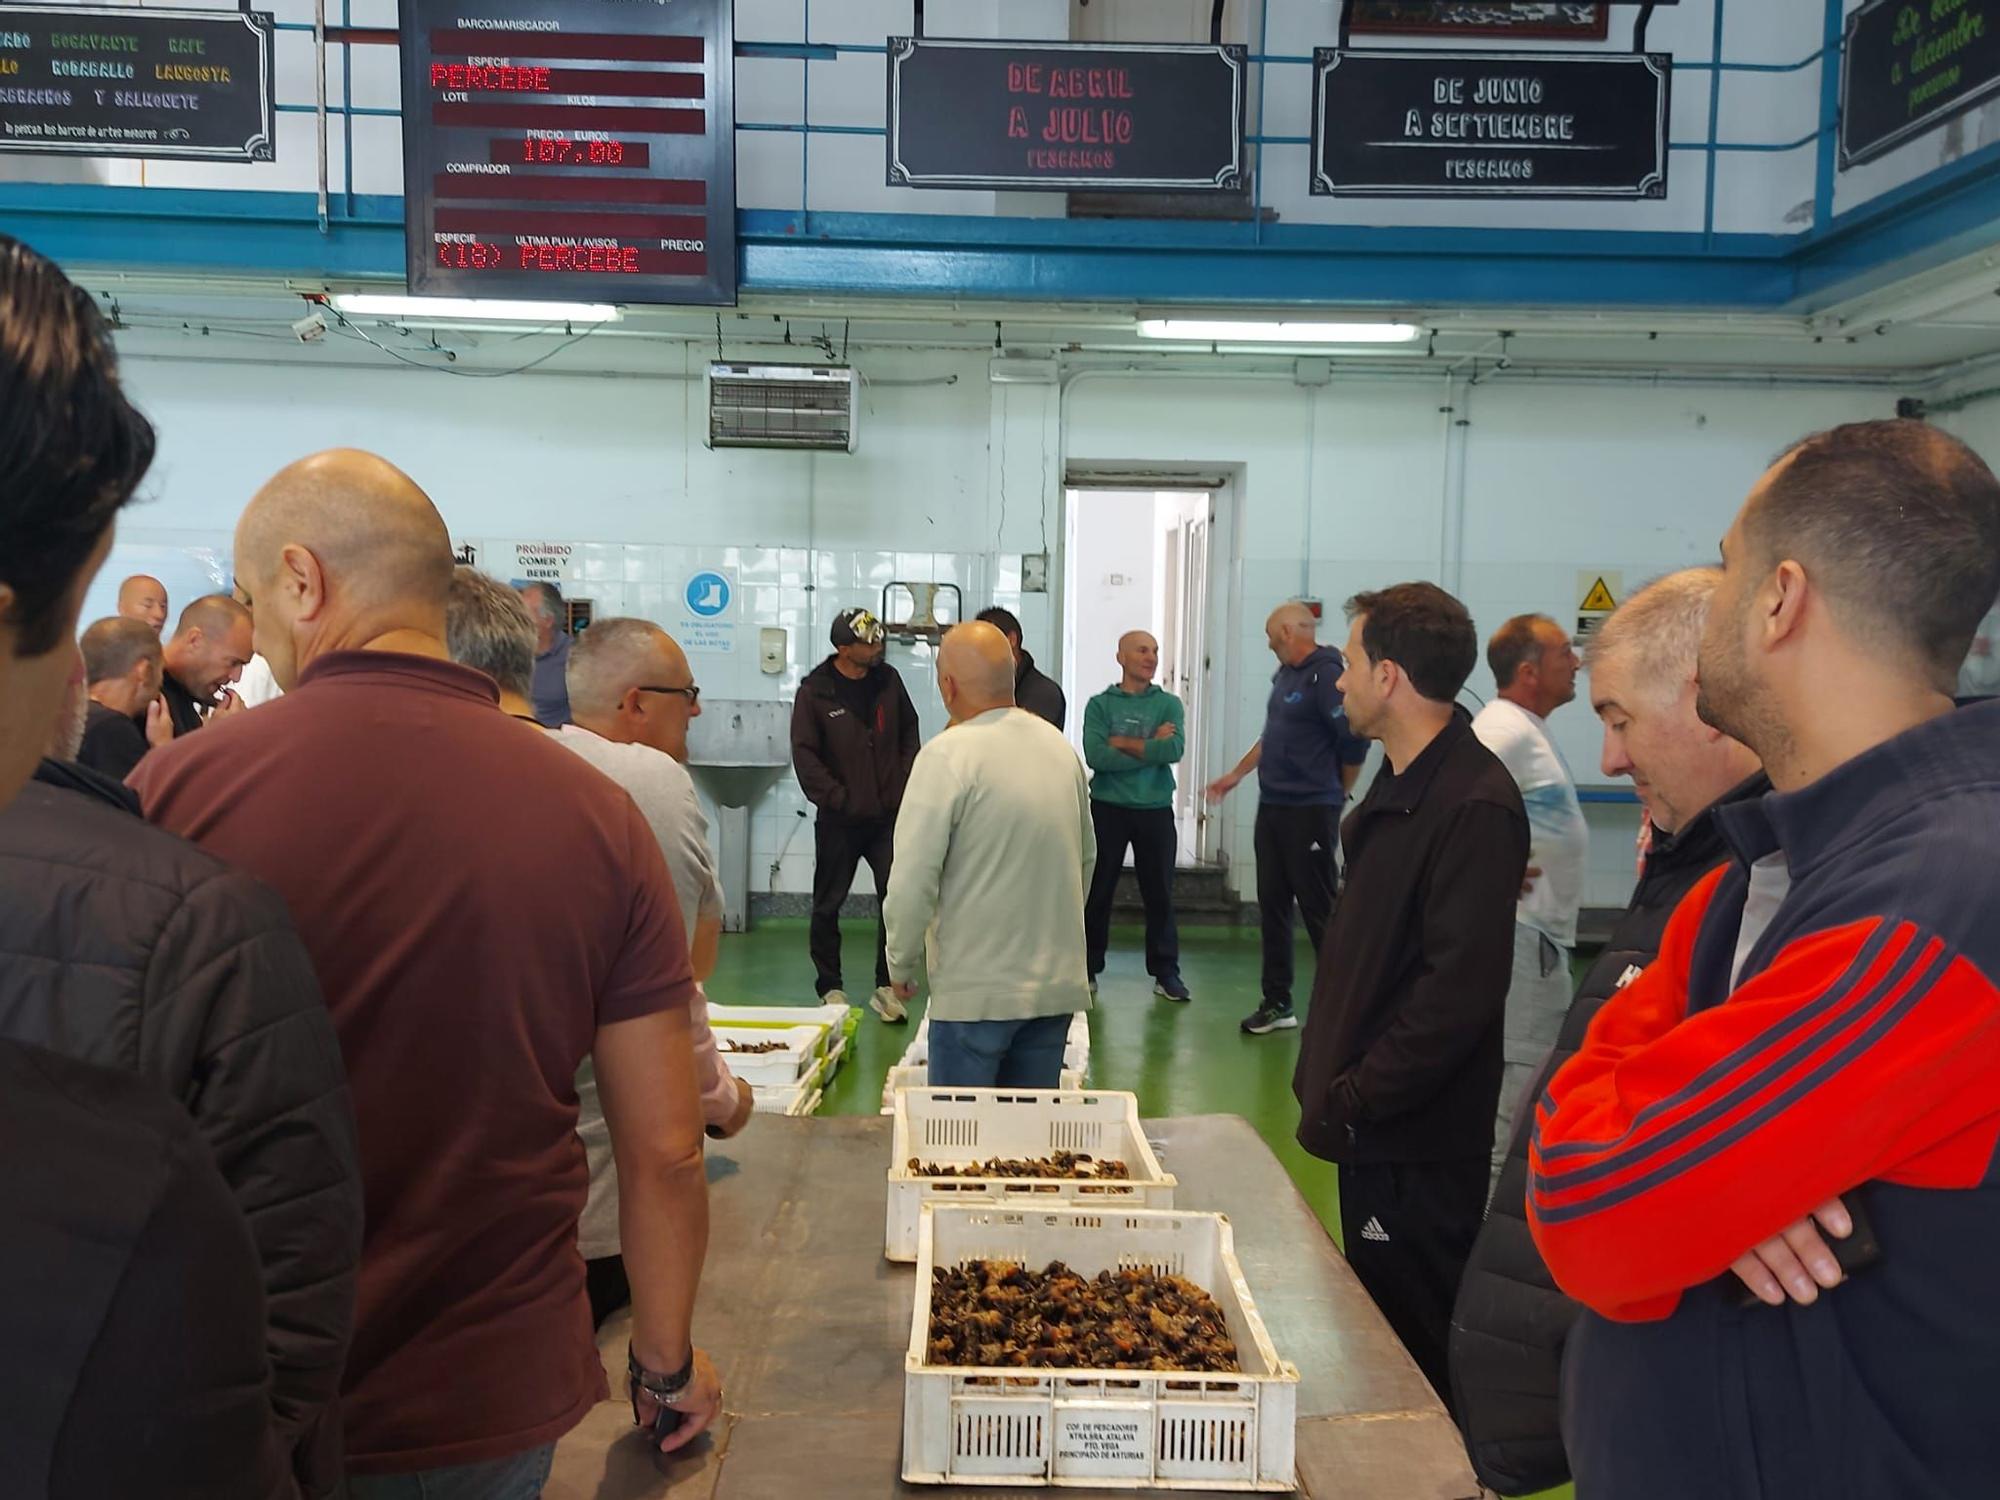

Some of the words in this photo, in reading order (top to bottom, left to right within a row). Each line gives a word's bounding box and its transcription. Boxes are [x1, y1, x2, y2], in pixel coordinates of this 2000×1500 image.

[457, 18, 560, 31] BARCO/MARISCADOR
[0, 31, 31, 50] ADO
[467, 56, 510, 67] ESPECIE
[0, 59, 19, 76] LO
[154, 64, 232, 83] LANGOSTA
[431, 63, 550, 90] PERCEBE
[1007, 62, 1043, 93] DE
[1049, 68, 1134, 99] ABRIL
[442, 92, 468, 103] LOTE
[1433, 77, 1464, 104] DE
[1473, 78, 1544, 105] JUNIO
[115, 90, 199, 110] SALMONETE
[567, 95, 597, 106] KILOS
[1007, 105, 1029, 139] A
[1042, 107, 1134, 144] JULIO
[1404, 108, 1423, 138] A
[1431, 112, 1574, 140] SEPTIEMBRE
[526, 129, 564, 140] PRECIO
[574, 130, 609, 141] EUROS
[1027, 149, 1116, 169] PESCAMOS
[446, 162, 511, 175] COMPRADOR
[1445, 159, 1534, 179] PESCAMOS
[434, 232, 477, 244] ESPECIE
[661, 239, 704, 252] PRECIO
[520, 244, 641, 273] PERCEBE
[518, 556, 556, 566] COMER
[560, 557, 568, 566] Y
[526, 569, 560, 578] BEBER
[1093, 1424, 1138, 1432] PESCADORES
